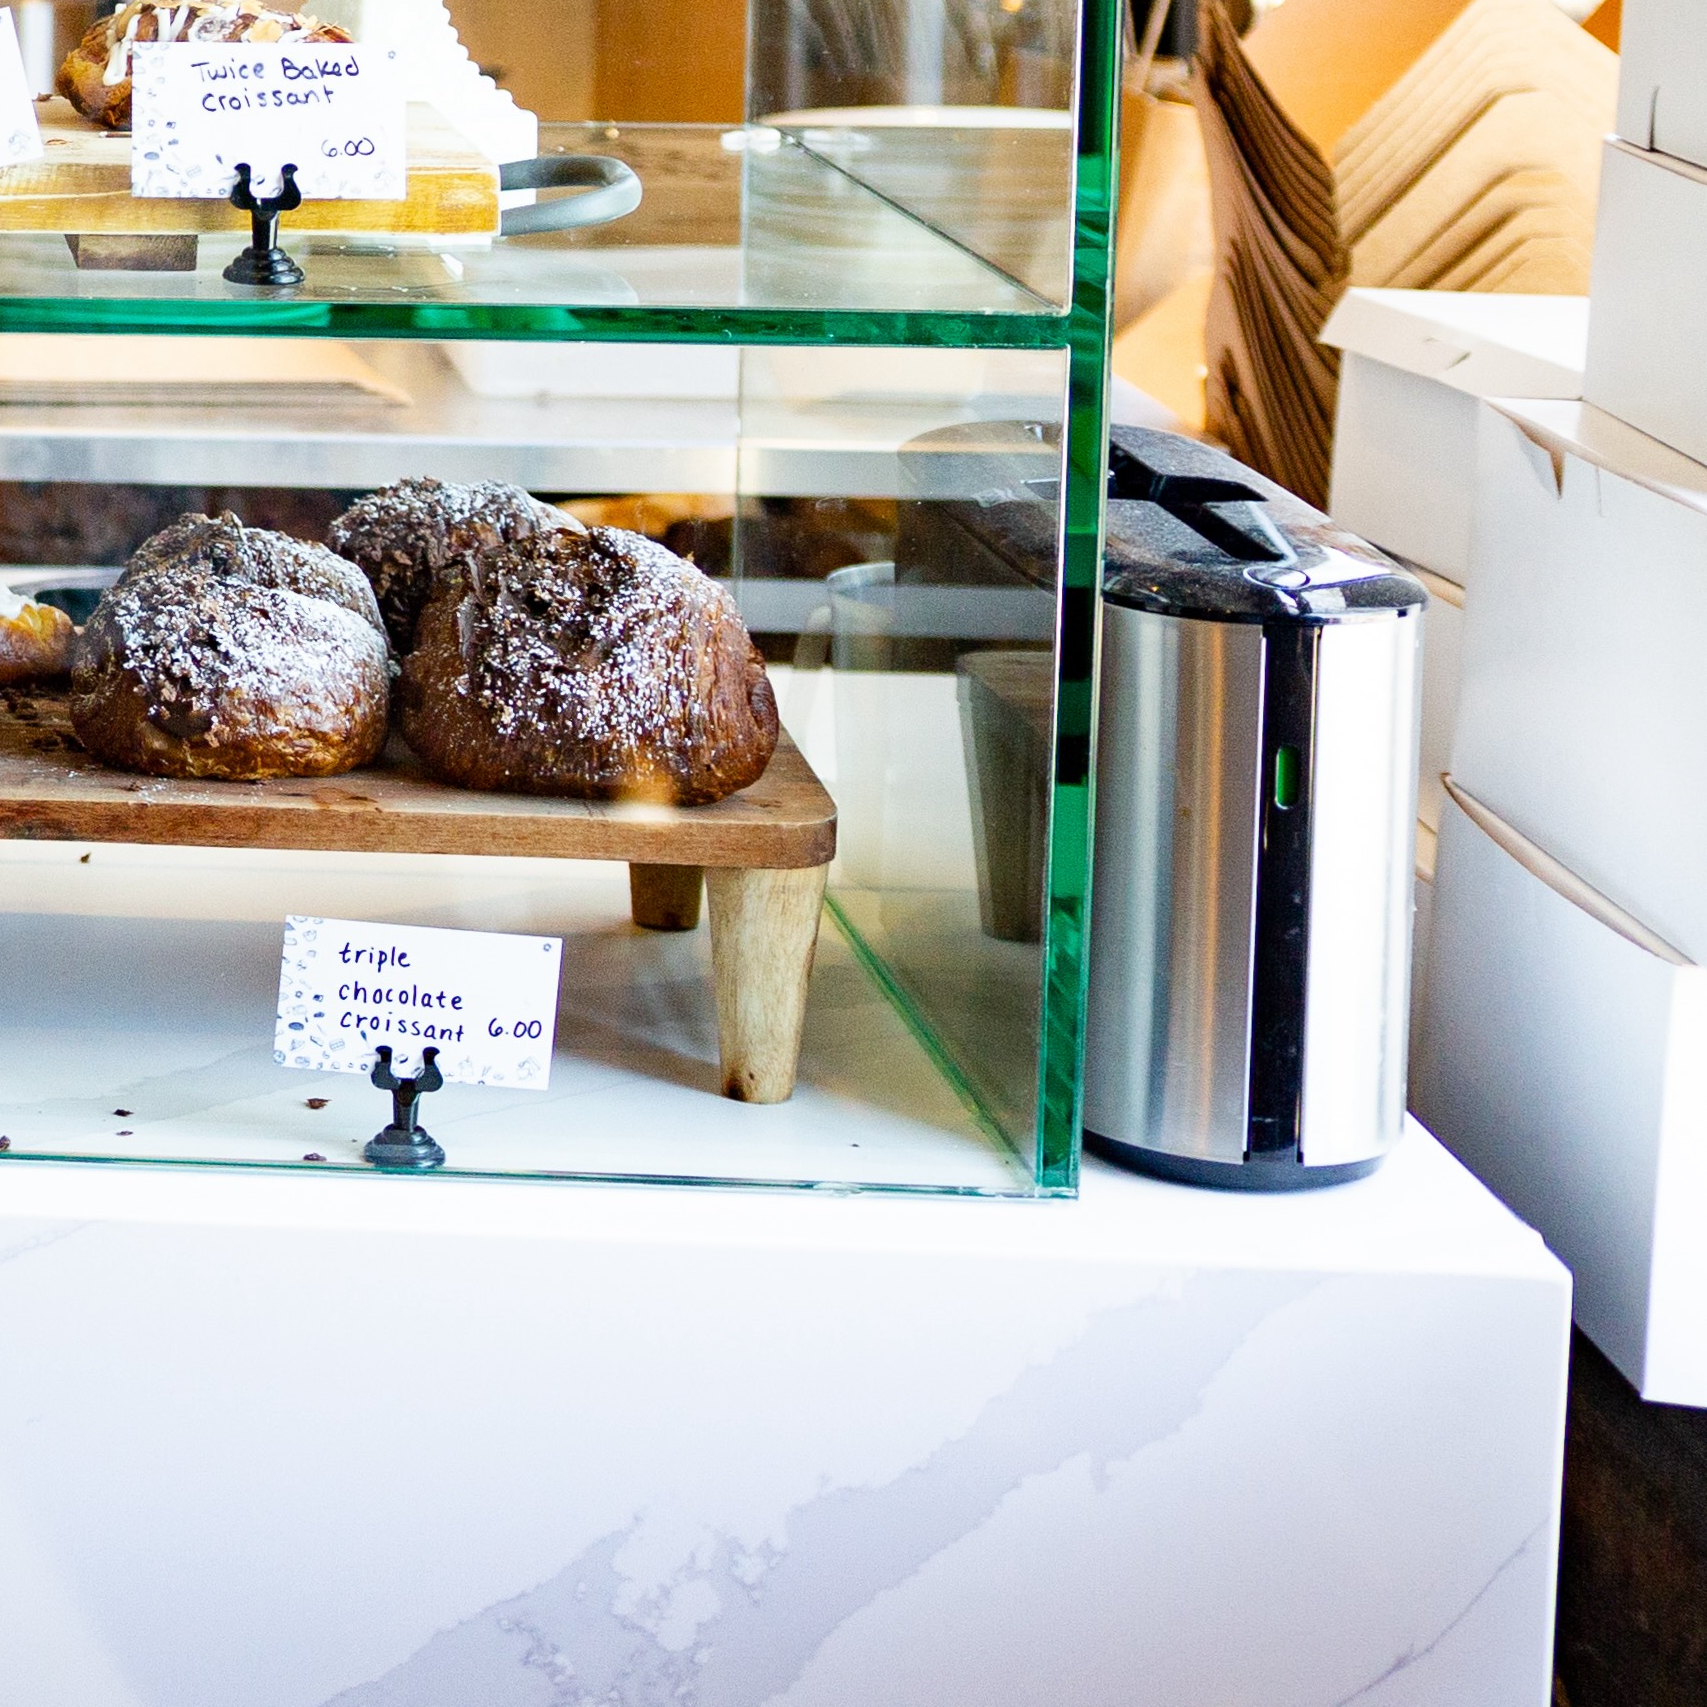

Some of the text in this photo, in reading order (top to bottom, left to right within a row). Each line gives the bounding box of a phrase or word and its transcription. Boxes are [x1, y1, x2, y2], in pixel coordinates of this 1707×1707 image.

[190, 55, 360, 83] Twice Baked
[321, 137, 375, 158] 6.00
[339, 942, 411, 973] triple
[339, 981, 464, 1011] chocolate
[340, 1011, 543, 1042] croissant 6.00
